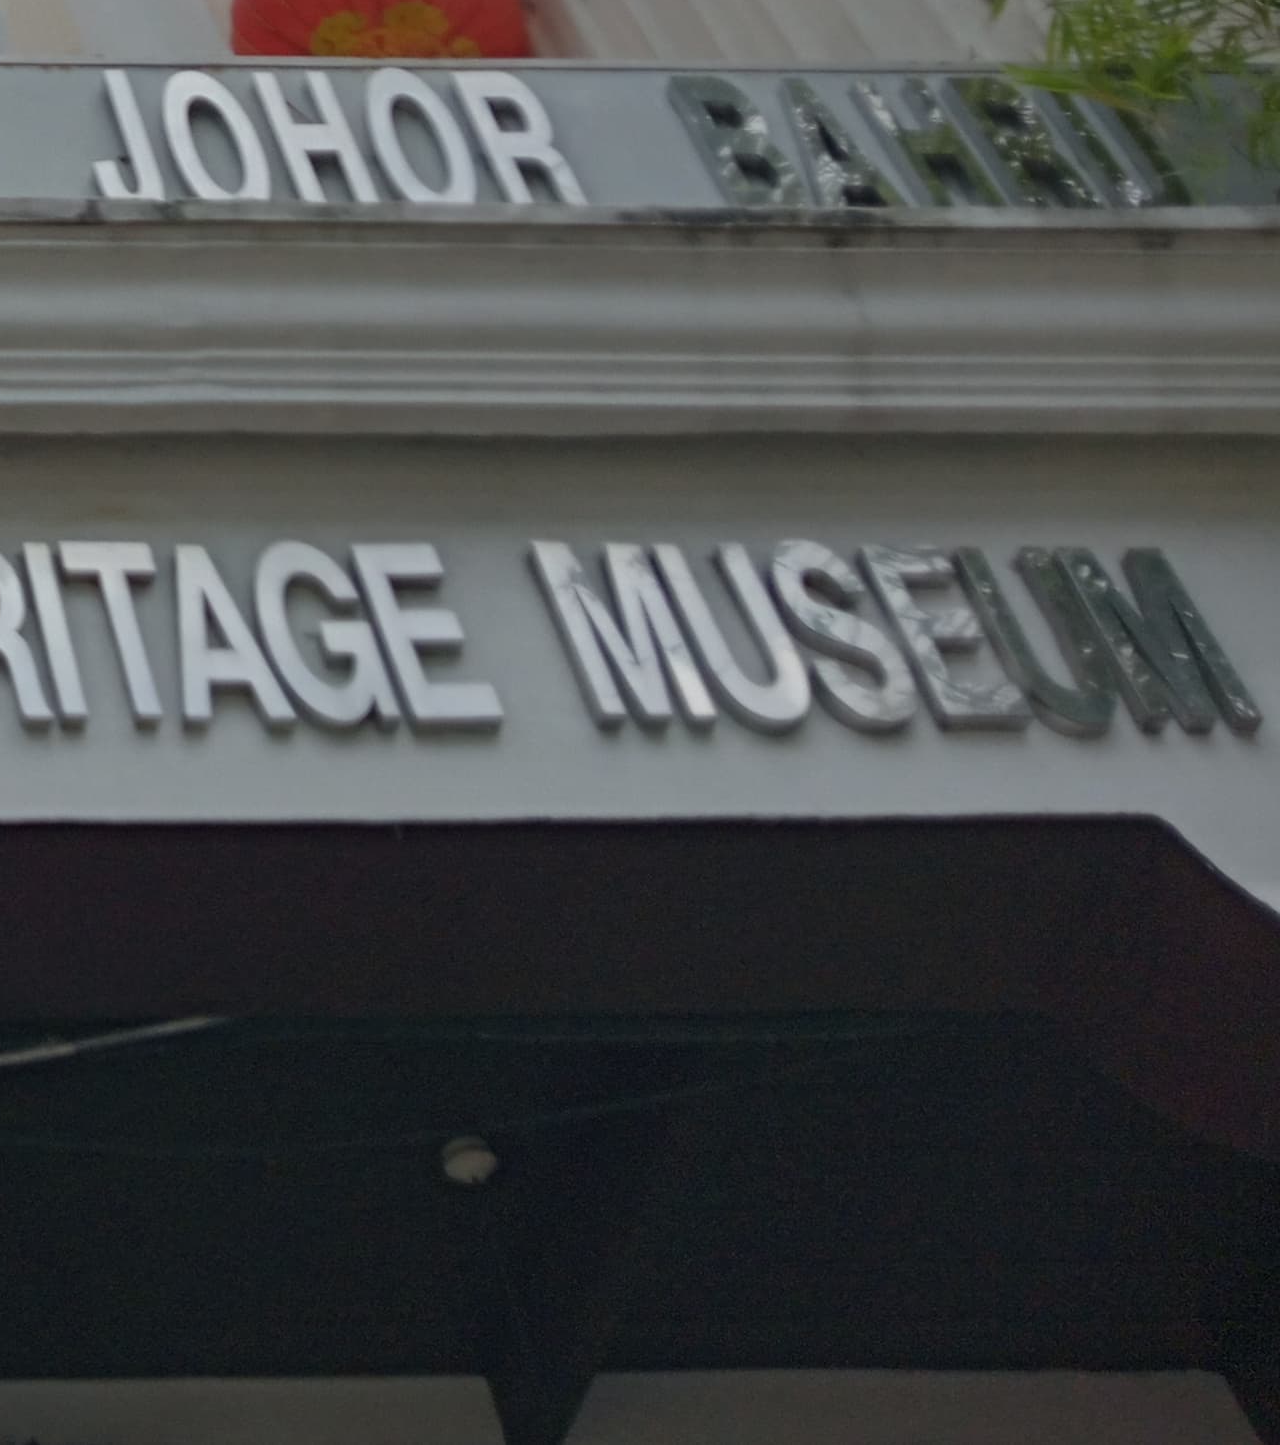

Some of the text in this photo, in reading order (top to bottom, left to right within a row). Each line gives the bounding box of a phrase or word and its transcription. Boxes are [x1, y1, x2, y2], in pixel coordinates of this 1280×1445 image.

[90, 66, 590, 204] JOHOR
[666, 74, 1194, 206] BAHRU
[526, 539, 1262, 736] MUSEUM
